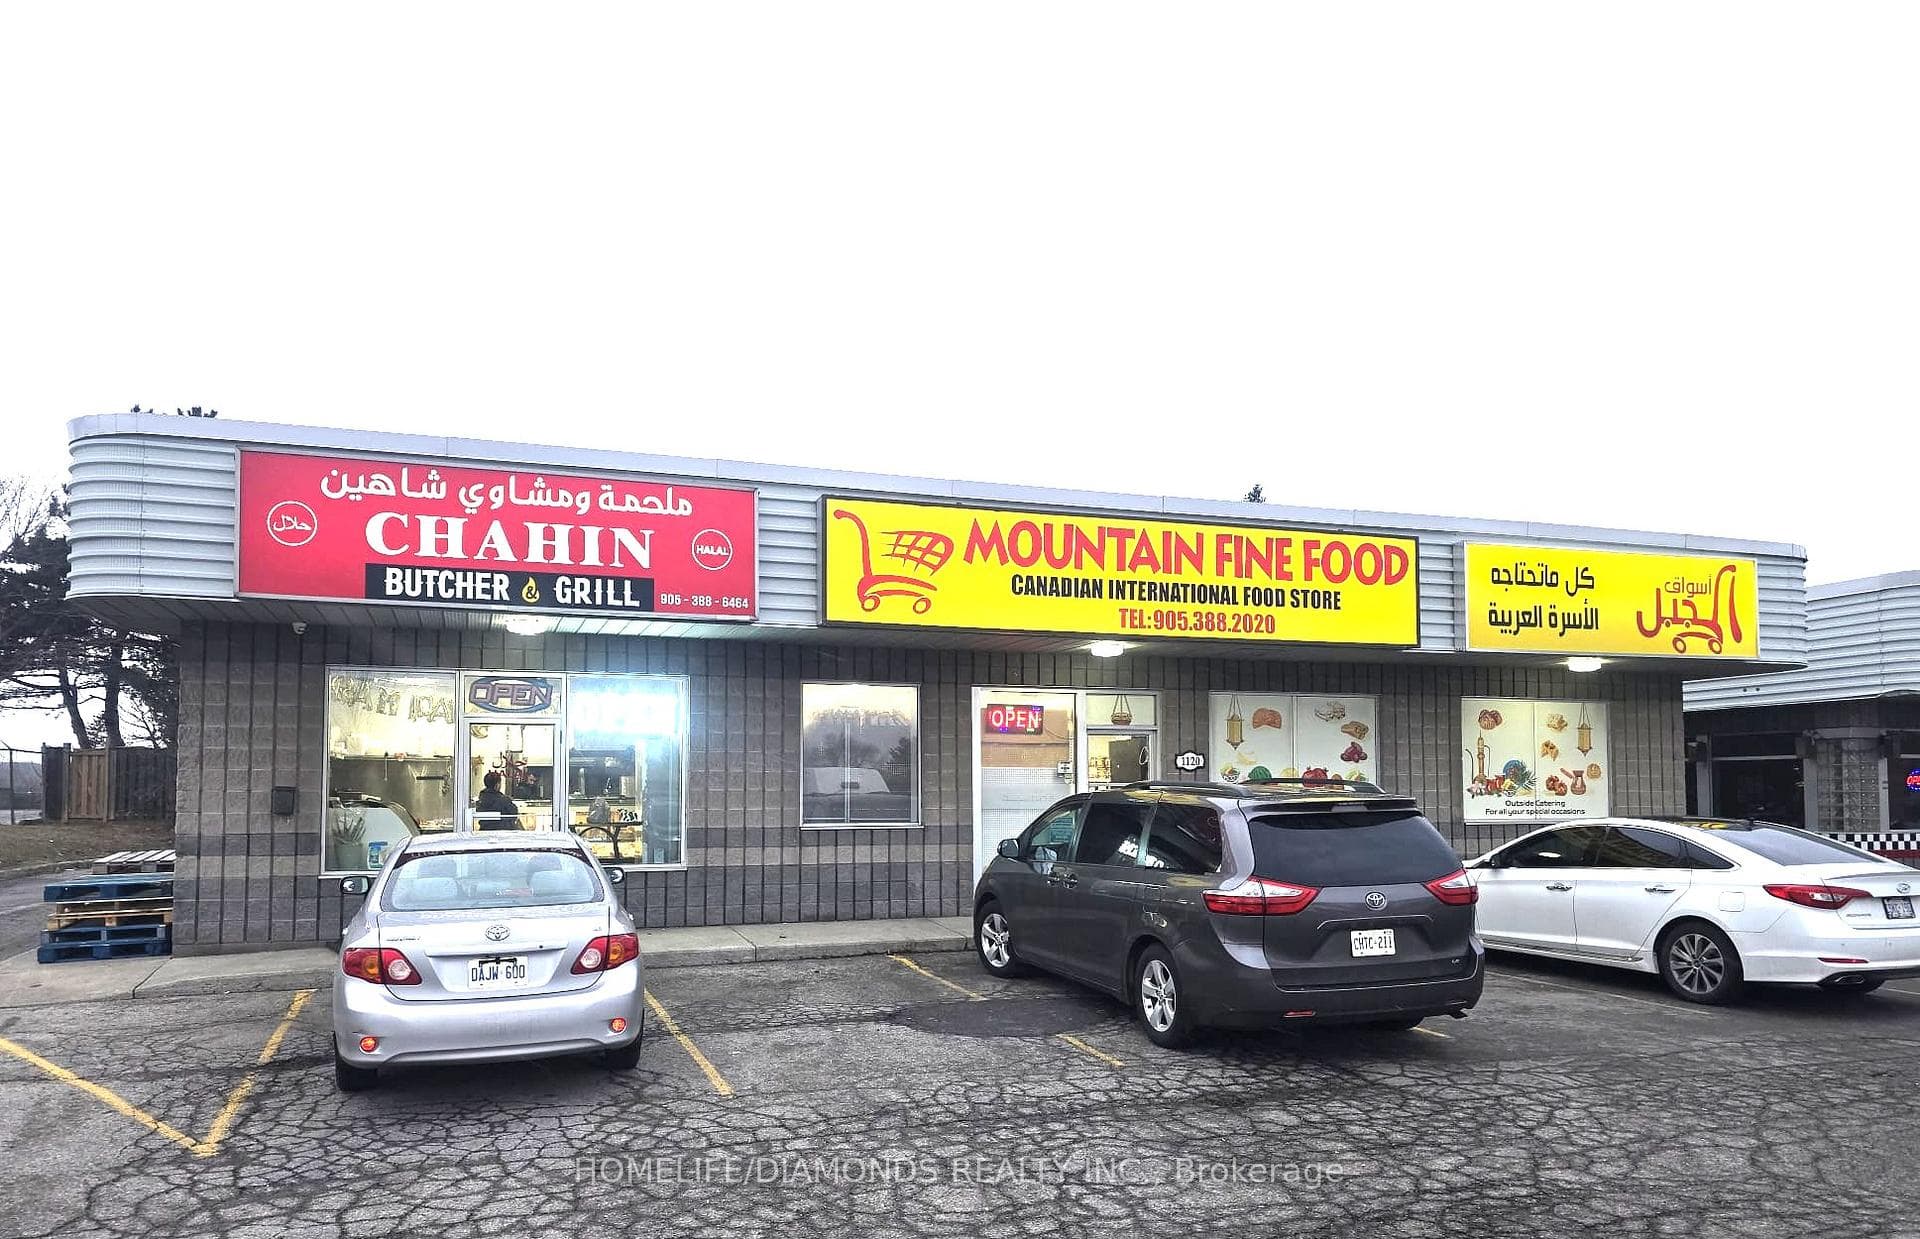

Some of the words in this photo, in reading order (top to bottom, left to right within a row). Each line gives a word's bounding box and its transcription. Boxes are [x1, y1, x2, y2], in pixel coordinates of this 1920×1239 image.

[320, 466, 447, 501] شاهين
[458, 474, 591, 515] ومشاوي
[598, 484, 693, 516] ملحمة
[273, 514, 312, 532] حلال
[365, 511, 655, 570] CHAHIN
[695, 544, 730, 556] HALAL
[963, 517, 1204, 577] MOUNTAIN
[1215, 534, 1294, 582] FINE
[1303, 539, 1409, 586] FOOD
[384, 566, 510, 601] BUTCHER
[526, 585, 539, 600] &
[554, 575, 640, 607] GRILL
[1011, 573, 1103, 599] CANADIAN
[1108, 579, 1239, 606] INTERNATIONAL
[1243, 586, 1286, 607] FOOD
[1290, 588, 1342, 610] STORE
[1565, 566, 1595, 597] كل
[1664, 573, 1712, 598] أسواق
[1488, 601, 1542, 636] العربية
[1548, 598, 1599, 637] الأسرة
[469, 682, 552, 706] OPEN
[991, 709, 1040, 729] OPEN
[1180, 756, 1201, 766] 1120
[1535, 800, 1566, 808] Catering
[471, 965, 499, 982] DAJW
[505, 964, 526, 979] 600
